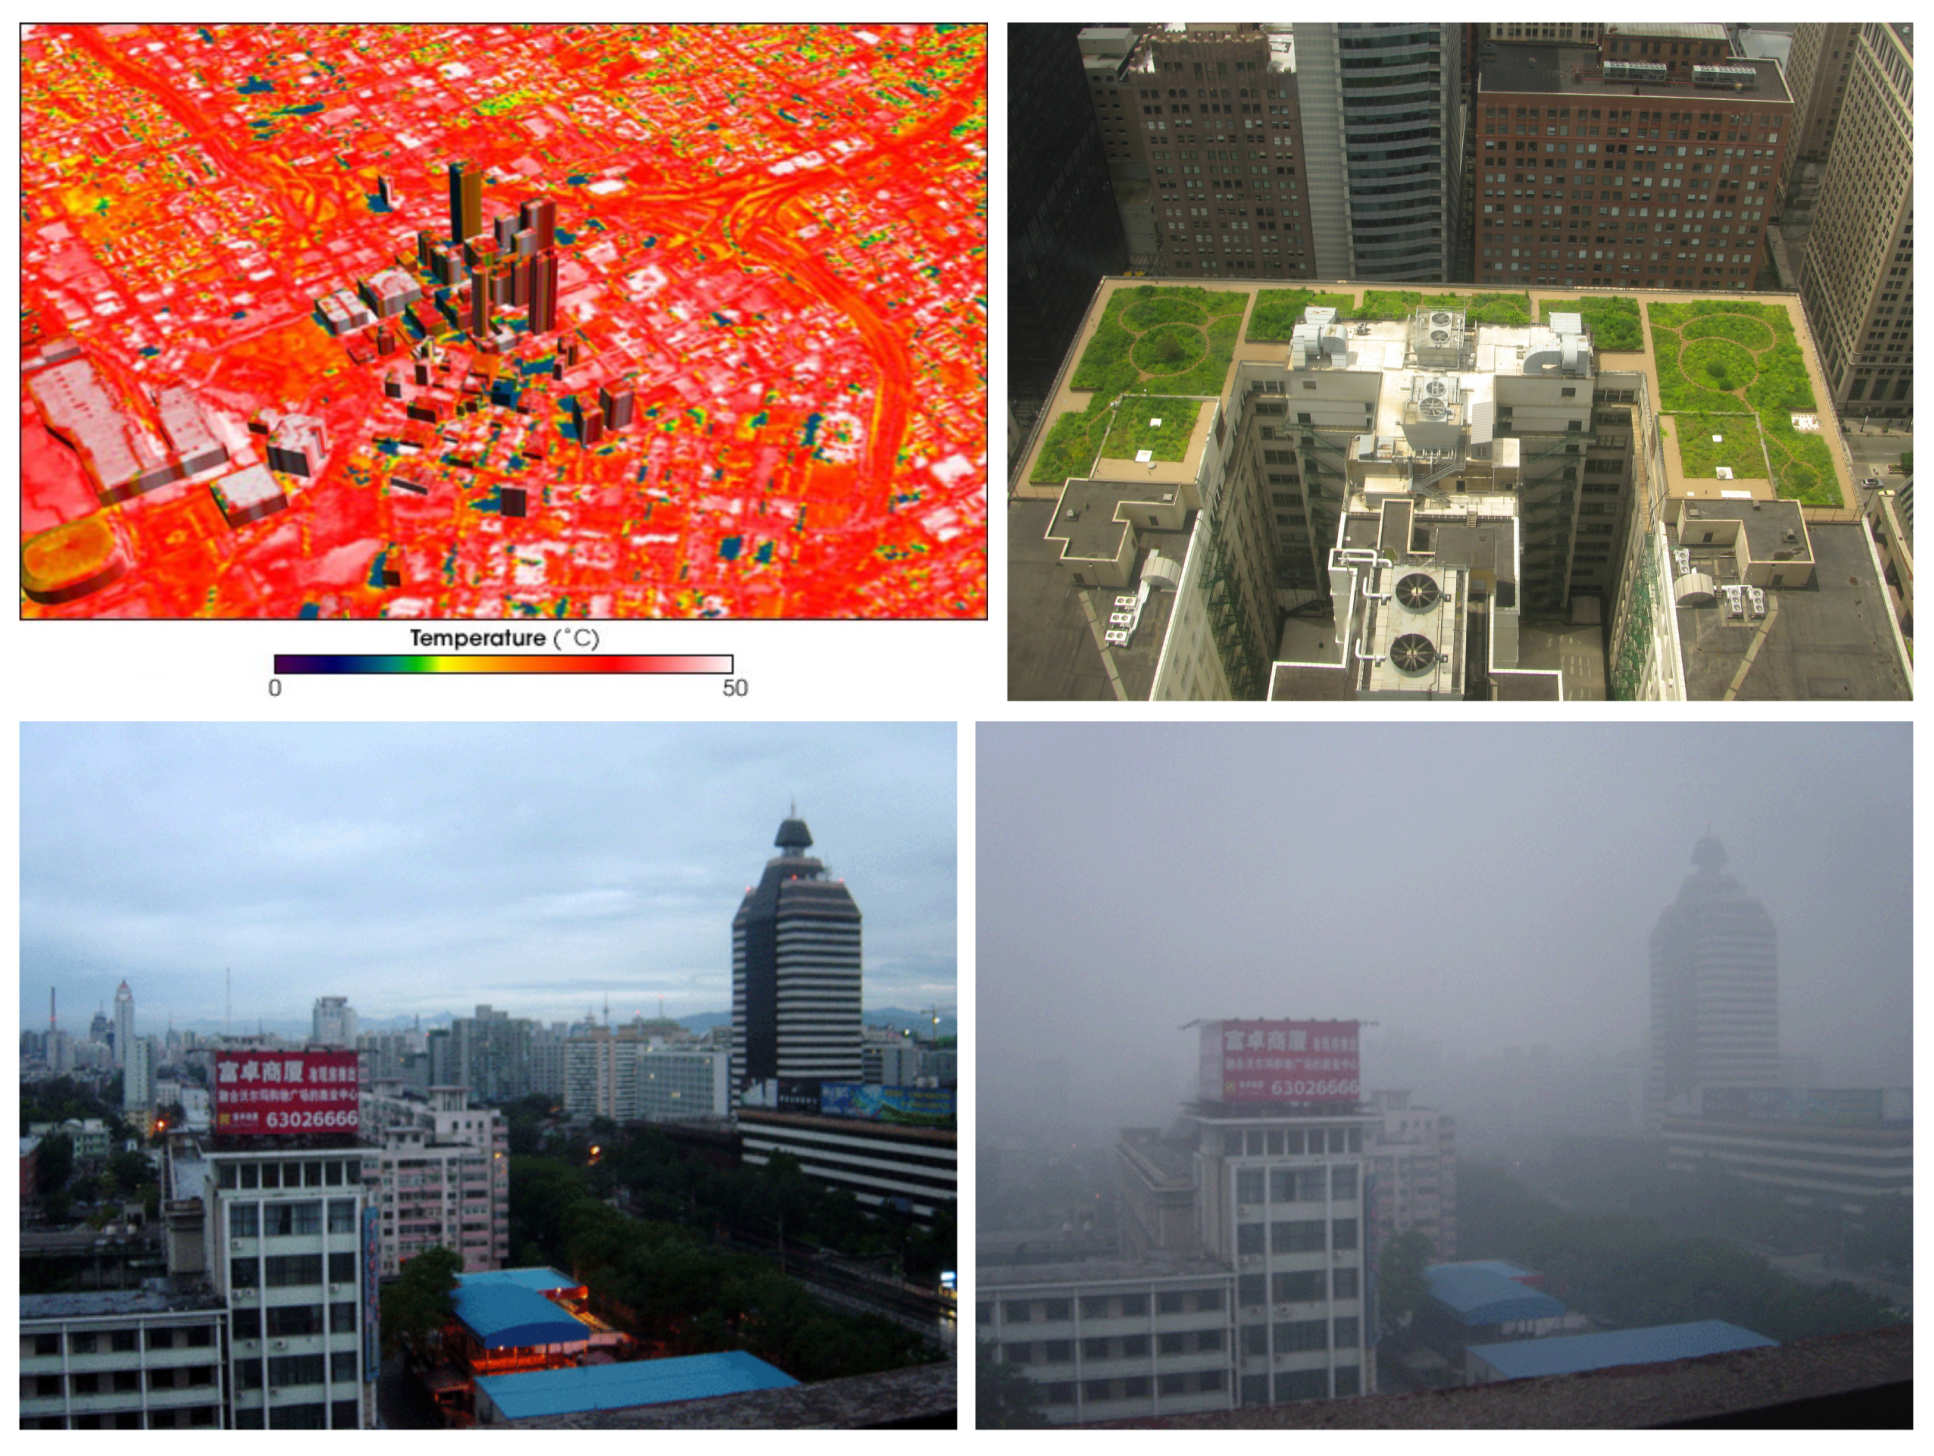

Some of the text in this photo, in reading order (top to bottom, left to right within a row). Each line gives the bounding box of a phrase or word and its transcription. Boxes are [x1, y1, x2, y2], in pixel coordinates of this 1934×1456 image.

[218, 1060, 304, 1083] 富卓商厦
[266, 1110, 358, 1128] 63026666
